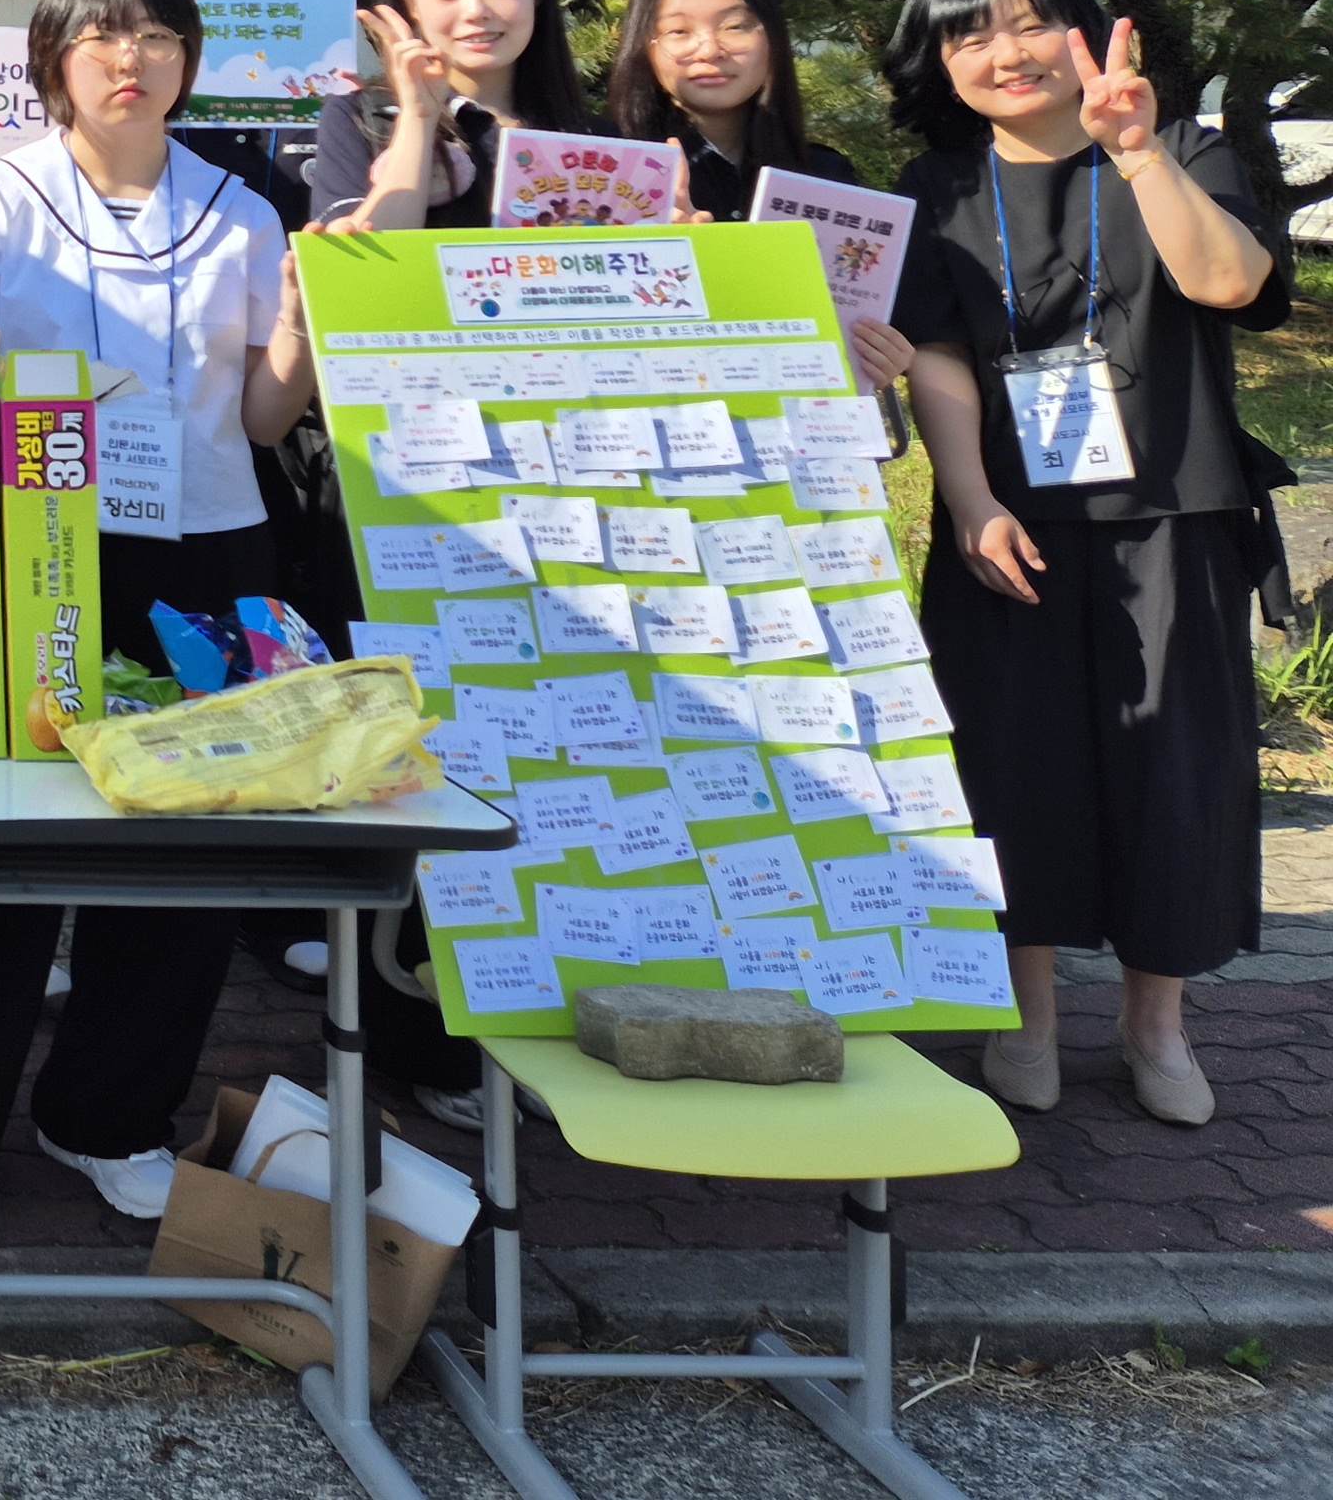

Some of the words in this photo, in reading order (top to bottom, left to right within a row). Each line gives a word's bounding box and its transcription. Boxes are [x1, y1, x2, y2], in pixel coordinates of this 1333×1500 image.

[230, 2, 263, 18] 다른
[560, 150, 619, 173] 다문화
[516, 174, 569, 204] 우리는
[575, 172, 610, 193] 모두
[770, 197, 799, 215] 우리
[801, 203, 830, 222] 모두
[490, 252, 650, 278] 다문화이해주간
[471, 331, 518, 344] 선택하여
[525, 329, 561, 342] 자신의
[17, 410, 44, 487] 가성비
[45, 411, 86, 489] 30개
[46, 496, 59, 543] 부드러운
[103, 496, 165, 522] 장선미
[63, 526, 74, 568] 카스타드
[36, 633, 46, 672] 오리온
[51, 603, 82, 714] 카스타드
